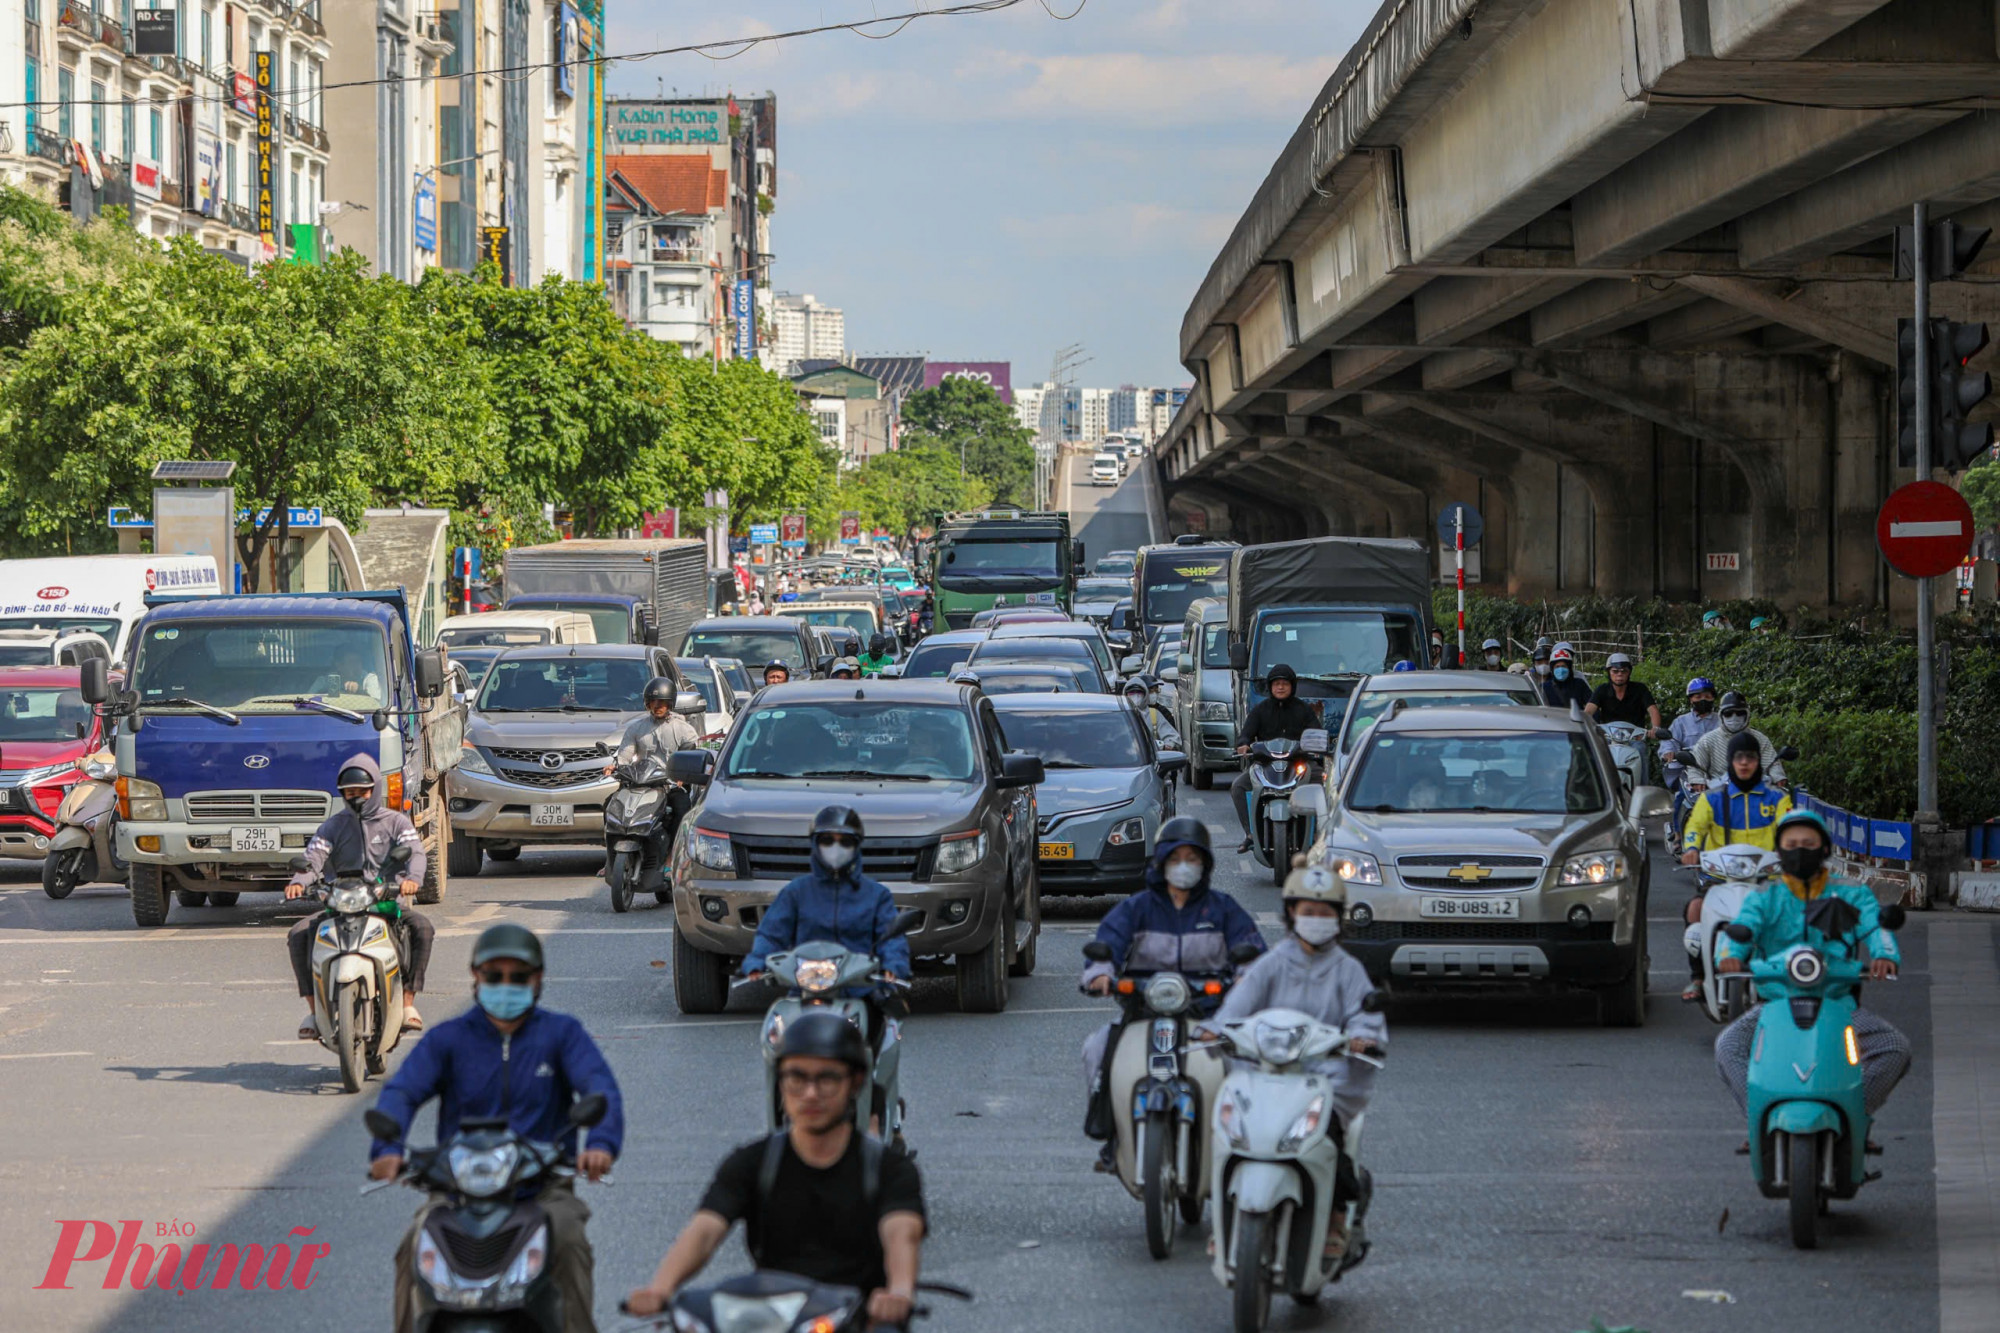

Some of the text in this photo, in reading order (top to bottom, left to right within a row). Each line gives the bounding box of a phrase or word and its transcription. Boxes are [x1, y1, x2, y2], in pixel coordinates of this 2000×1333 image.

[671, 107, 718, 123] Home
[259, 189, 272, 230] ANH
[296, 509, 317, 526] BỘ
[1709, 554, 1737, 568] T174
[40, 588, 67, 598] 215B
[33, 604, 52, 612] CAO
[543, 805, 562, 815] 30M
[1760, 801, 1776, 817] be
[536, 815, 569, 824] 467.84
[245, 828, 266, 839] 29H
[236, 840, 275, 850] 504.52
